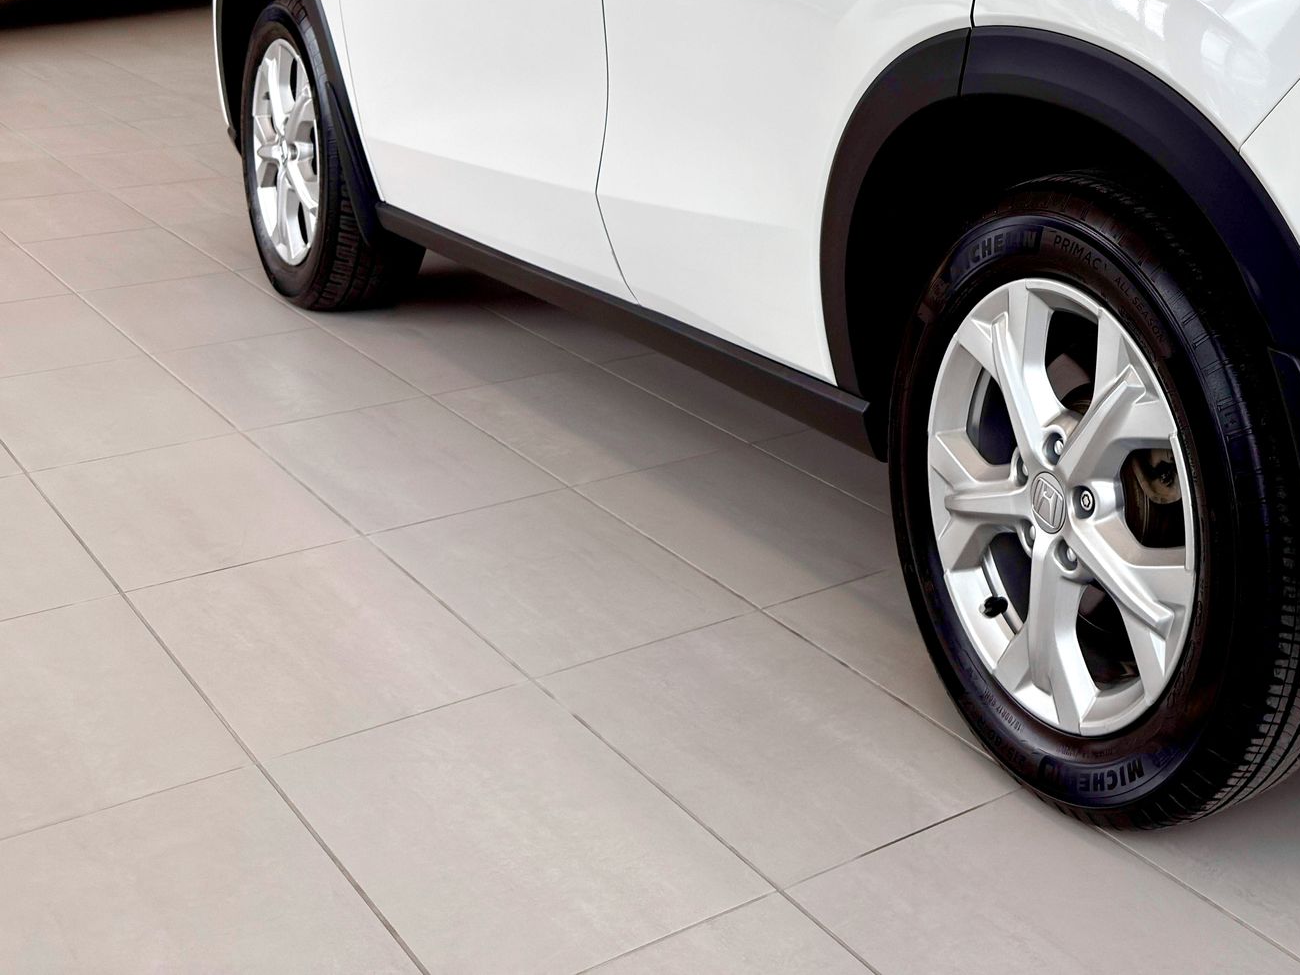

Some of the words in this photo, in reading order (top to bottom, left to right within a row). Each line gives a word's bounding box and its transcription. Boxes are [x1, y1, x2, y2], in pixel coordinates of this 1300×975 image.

[953, 227, 1038, 271] CHELIN
[1113, 275, 1132, 296] ALL
[1055, 757, 1145, 793] MICHEL
